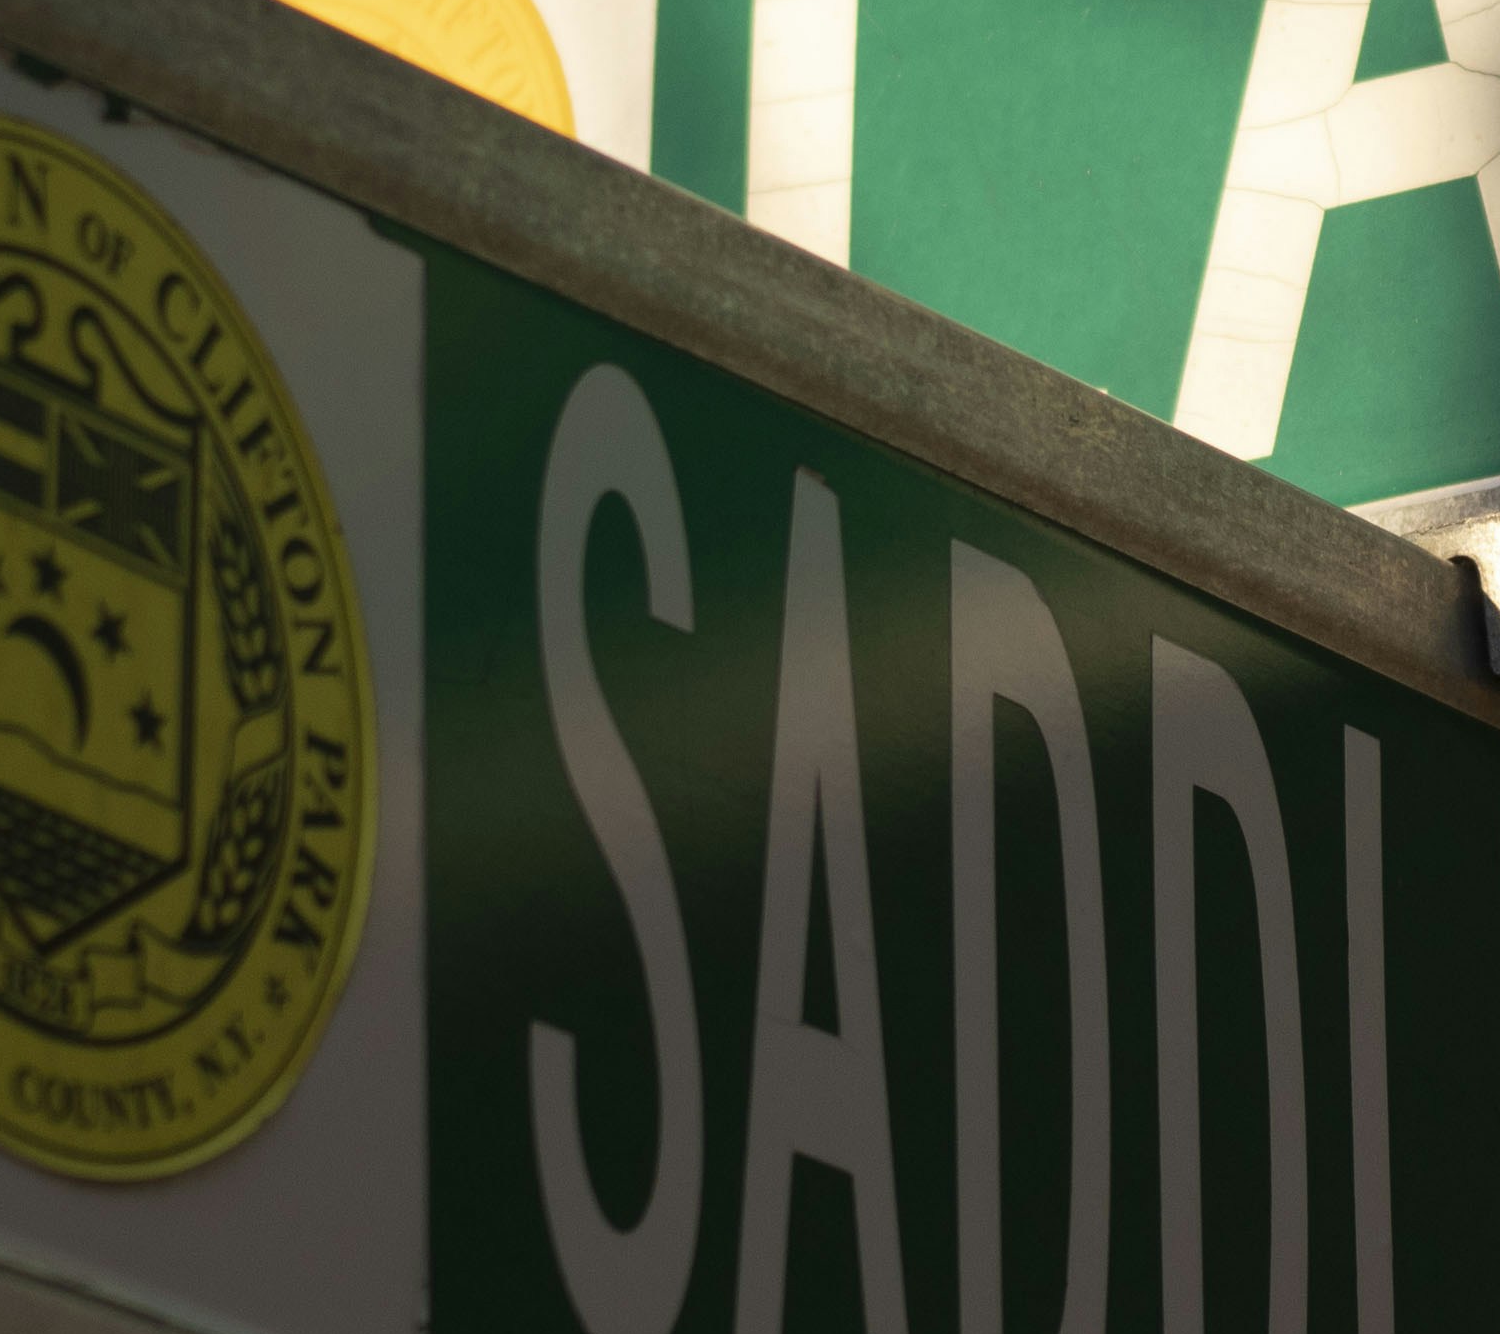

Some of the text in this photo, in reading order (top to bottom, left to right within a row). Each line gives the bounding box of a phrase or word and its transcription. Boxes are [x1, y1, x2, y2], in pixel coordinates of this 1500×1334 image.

[75, 211, 136, 278] OF
[155, 272, 343, 676] CLIFTON
[272, 729, 348, 980] PARK
